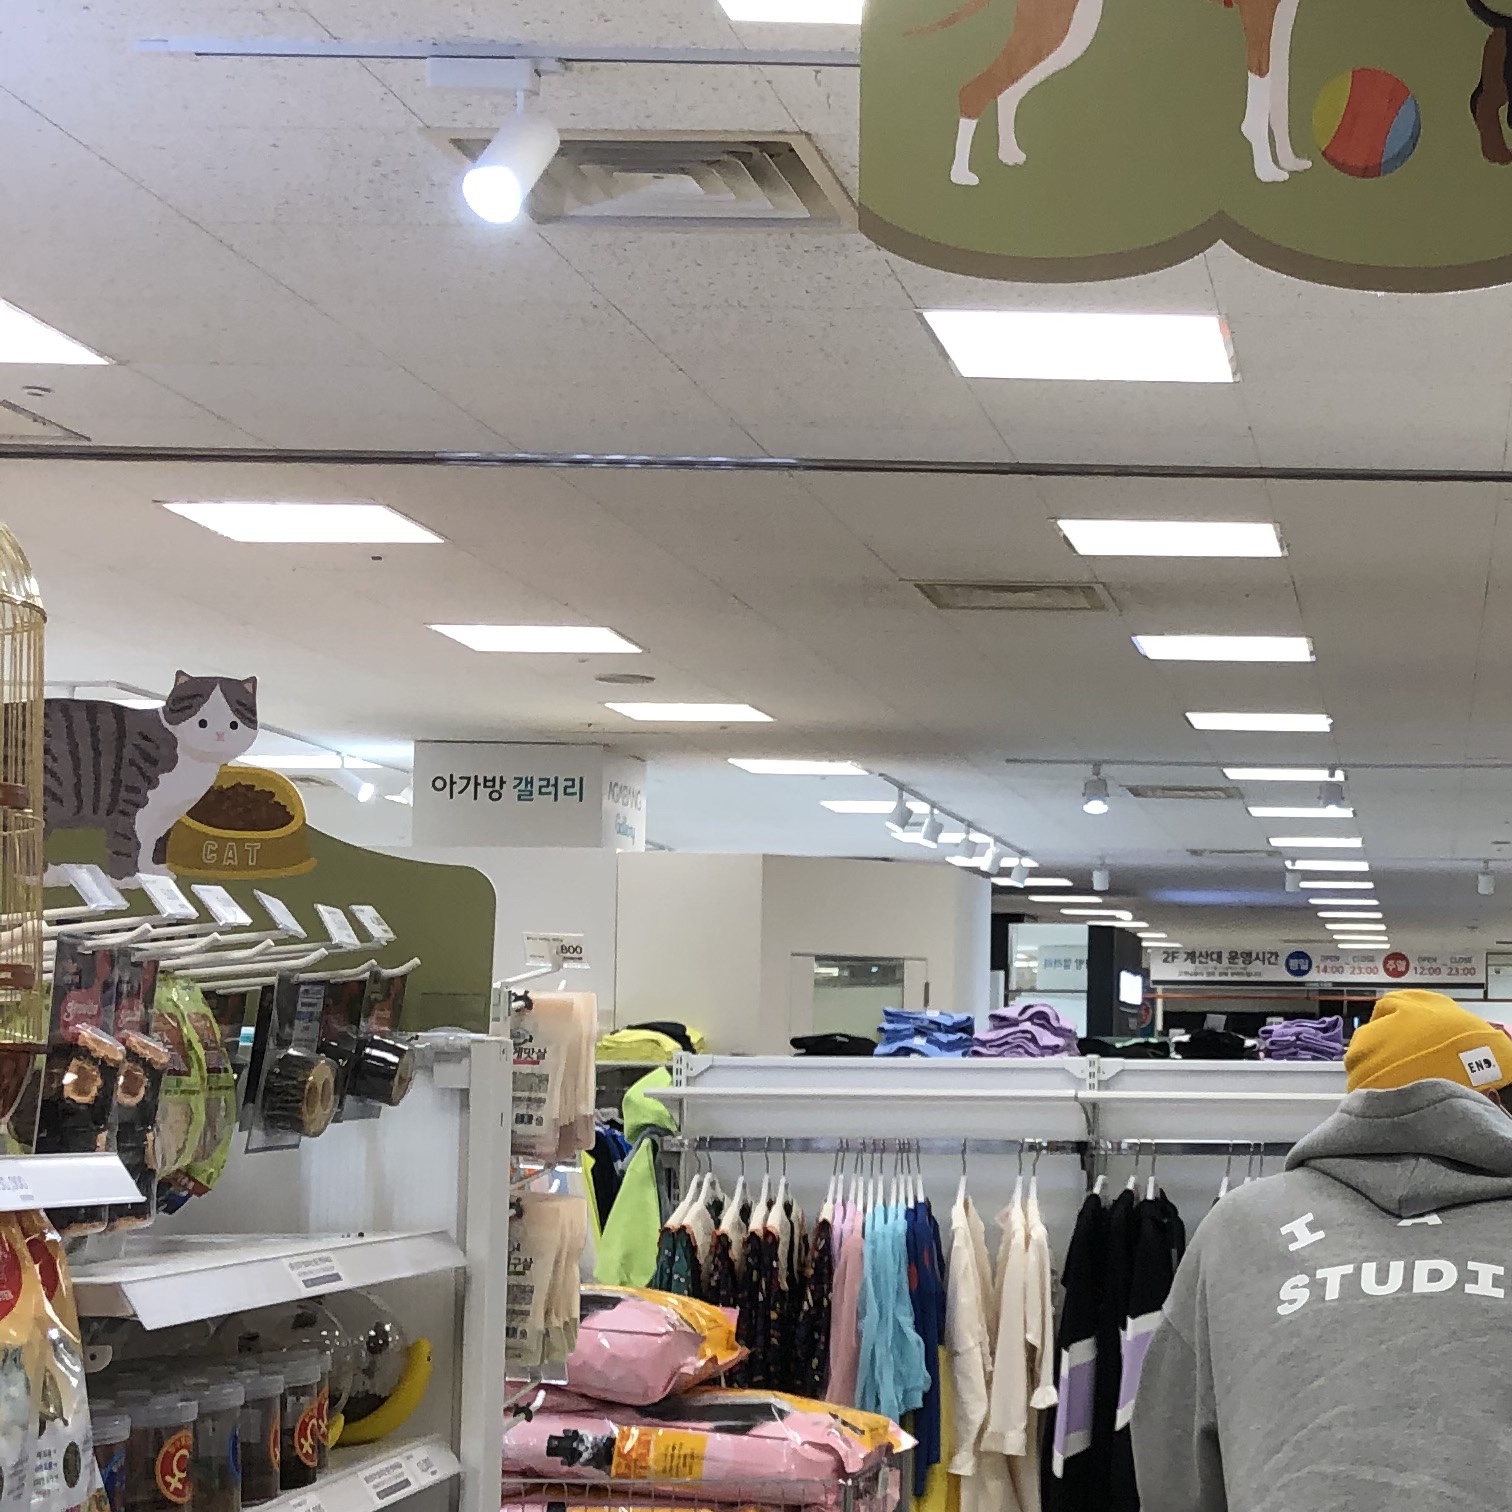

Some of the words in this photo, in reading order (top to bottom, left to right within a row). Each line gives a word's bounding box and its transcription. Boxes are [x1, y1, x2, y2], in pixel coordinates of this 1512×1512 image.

[431, 773, 506, 801] 아가방
[513, 775, 584, 802] 갤러리
[201, 840, 261, 866] CAT
[1162, 951, 1179, 964] 2F
[1183, 950, 1223, 965] 계산대
[1228, 950, 1279, 965] 운영시간
